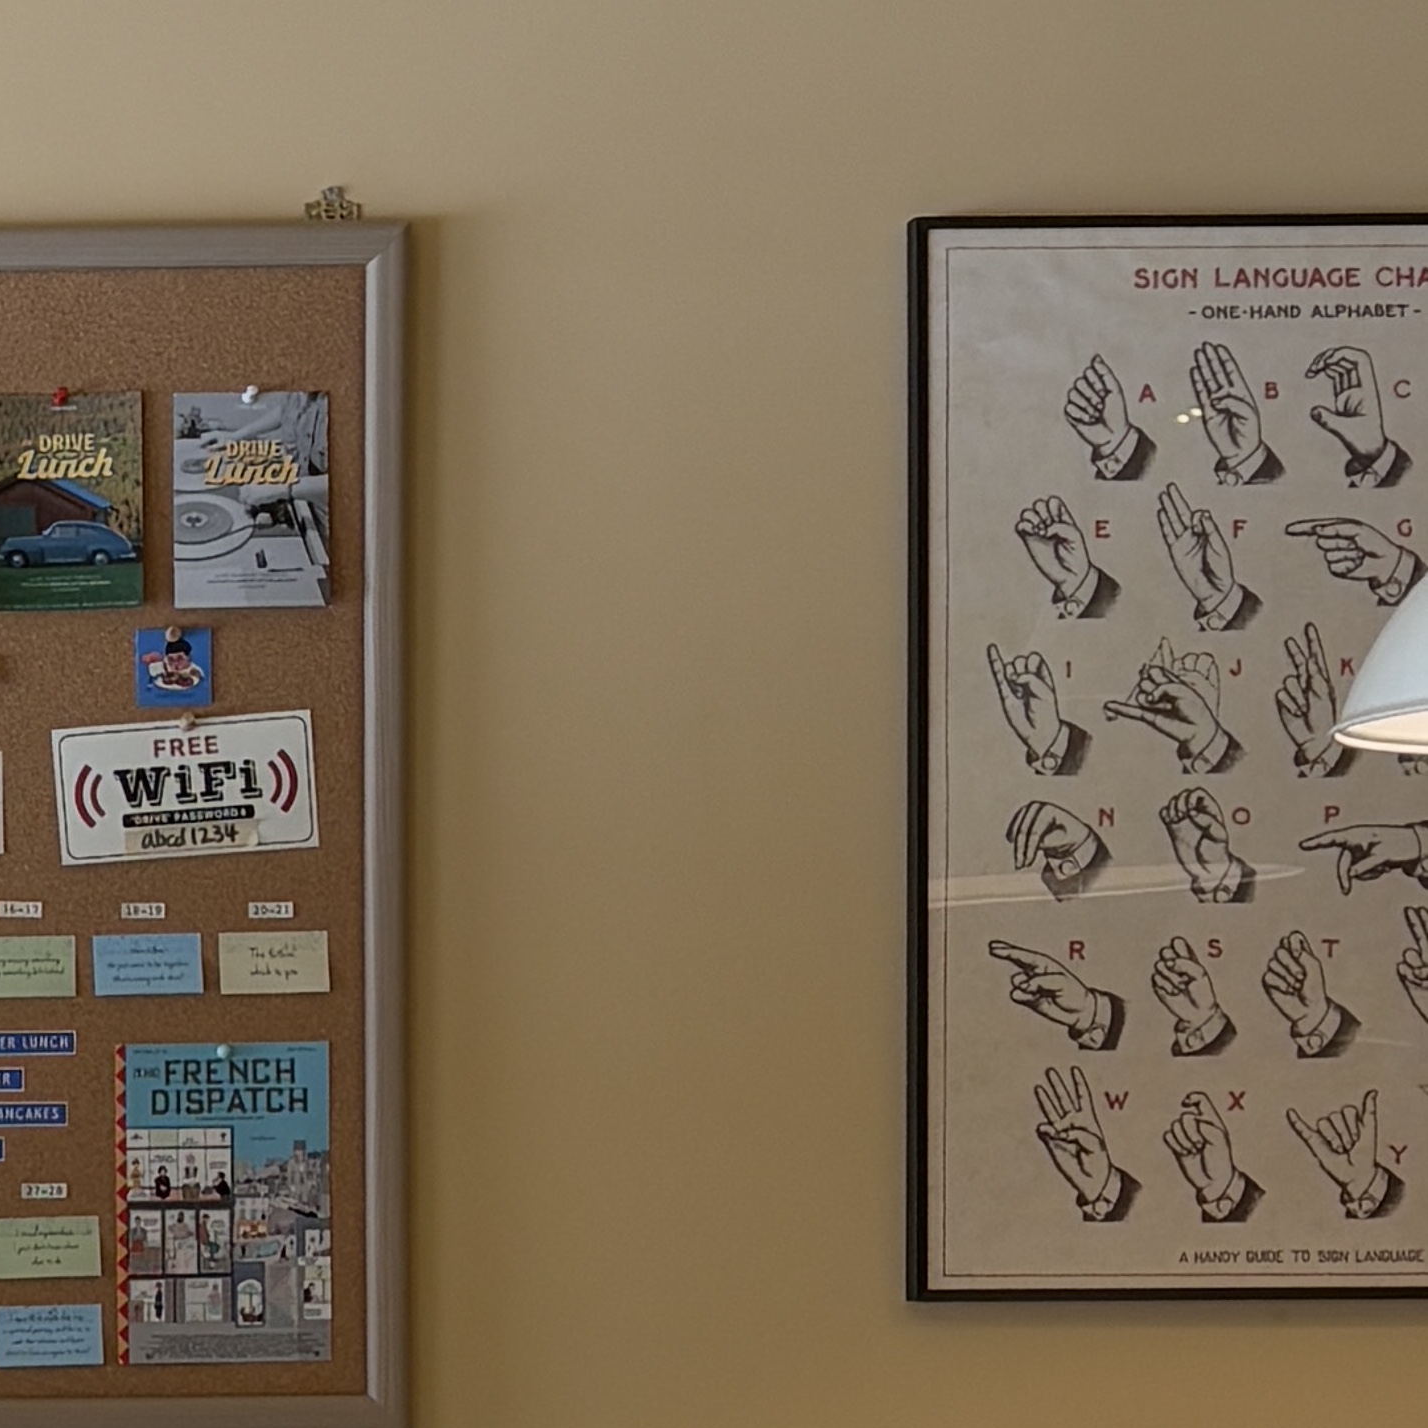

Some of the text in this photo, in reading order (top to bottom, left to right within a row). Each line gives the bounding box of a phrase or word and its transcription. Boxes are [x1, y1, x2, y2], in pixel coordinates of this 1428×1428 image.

[1134, 268, 1198, 289] SIGN
[1215, 267, 1361, 288] LANGUAGE
[1311, 304, 1409, 319] ALPHABET
[1139, 384, 1156, 402] A
[1264, 382, 1279, 400] B
[1394, 380, 1411, 398] C
[38, 434, 95, 453] DRIVE
[225, 439, 283, 459] DRIVE
[17, 448, 113, 480] Lunch
[203, 455, 301, 486] Lunch
[1095, 520, 1110, 538] E
[1234, 520, 1247, 538] F
[1397, 519, 1413, 537] G
[1229, 659, 1242, 677] J
[1340, 658, 1355, 676] K
[153, 736, 220, 758] FREE
[113, 759, 263, 808] WiFi
[1099, 808, 1114, 826] N
[1232, 807, 1251, 825] O
[1325, 806, 1339, 824] P
[126, 905, 163, 916] 18-19
[252, 905, 289, 916] 20-21
[1069, 941, 1085, 959] R
[1208, 939, 1222, 958] S
[1322, 940, 1339, 957] T
[22, 1035, 69, 1049] LUNCH
[165, 1057, 295, 1086] FRENCH
[151, 1087, 308, 1116] DISPATCH
[1105, 1092, 1129, 1110] W
[1228, 1092, 1245, 1110] X
[1389, 1145, 1408, 1164] Y
[1179, 1249, 1425, 1263] A HANDY GUIDE TO SIGN LANGUAGE
